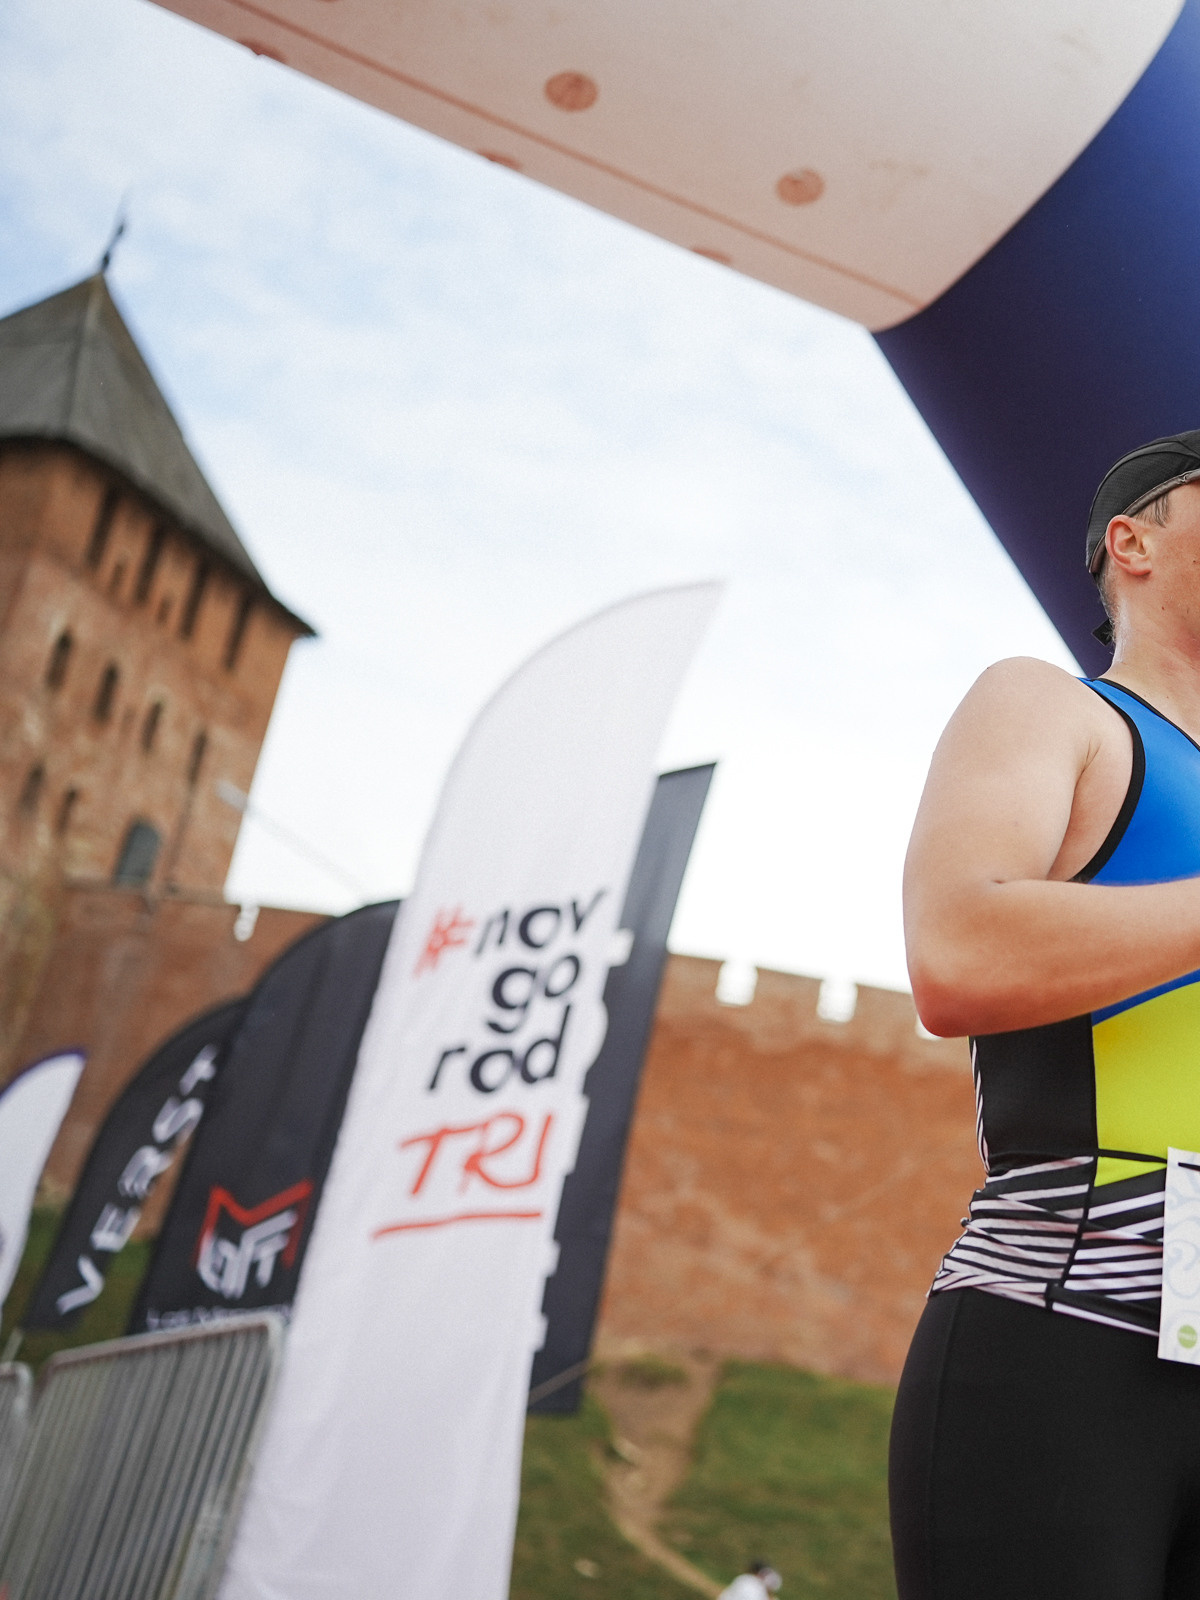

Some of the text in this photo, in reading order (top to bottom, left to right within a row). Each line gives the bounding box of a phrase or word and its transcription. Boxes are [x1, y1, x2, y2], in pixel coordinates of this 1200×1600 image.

[484, 950, 580, 1034] go
[426, 1002, 572, 1094] rod
[398, 1110, 554, 1197] TRI
